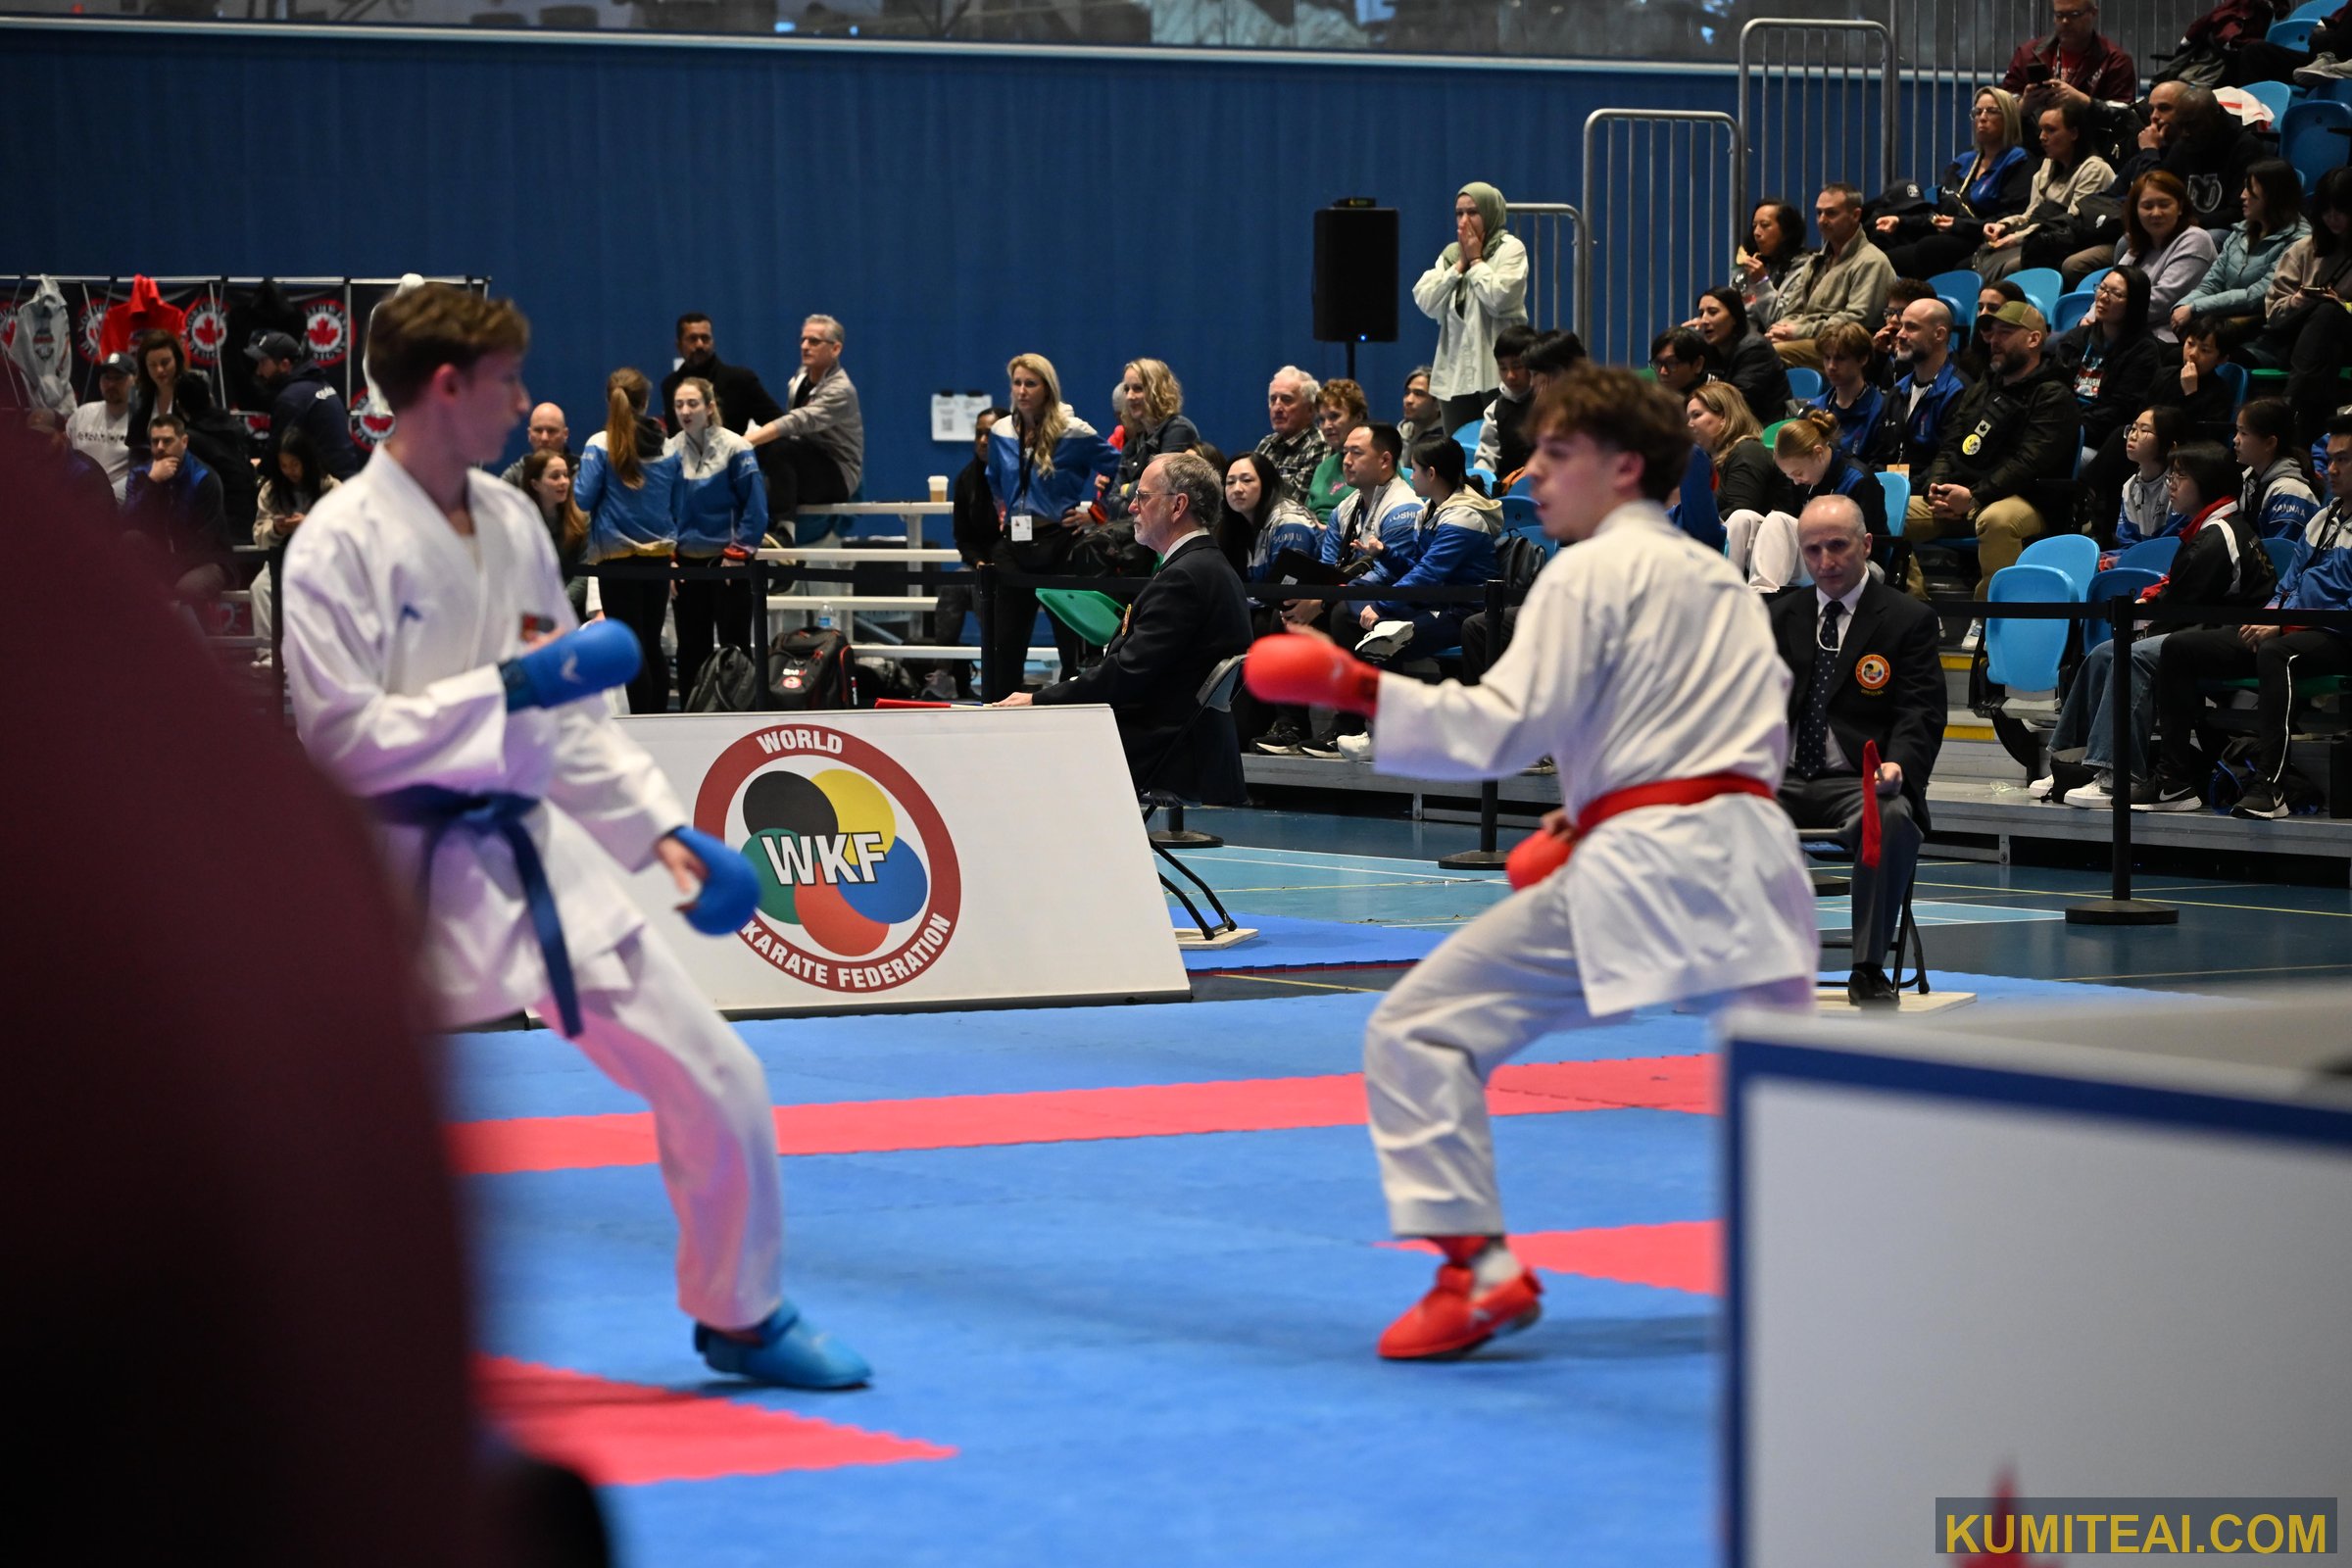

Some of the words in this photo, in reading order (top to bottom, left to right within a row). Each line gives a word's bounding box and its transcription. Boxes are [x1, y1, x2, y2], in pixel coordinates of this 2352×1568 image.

[756, 729, 843, 755] WORLD
[760, 831, 887, 886] WKF
[740, 920, 829, 984] KARATE
[837, 912, 951, 989] FEDERATION
